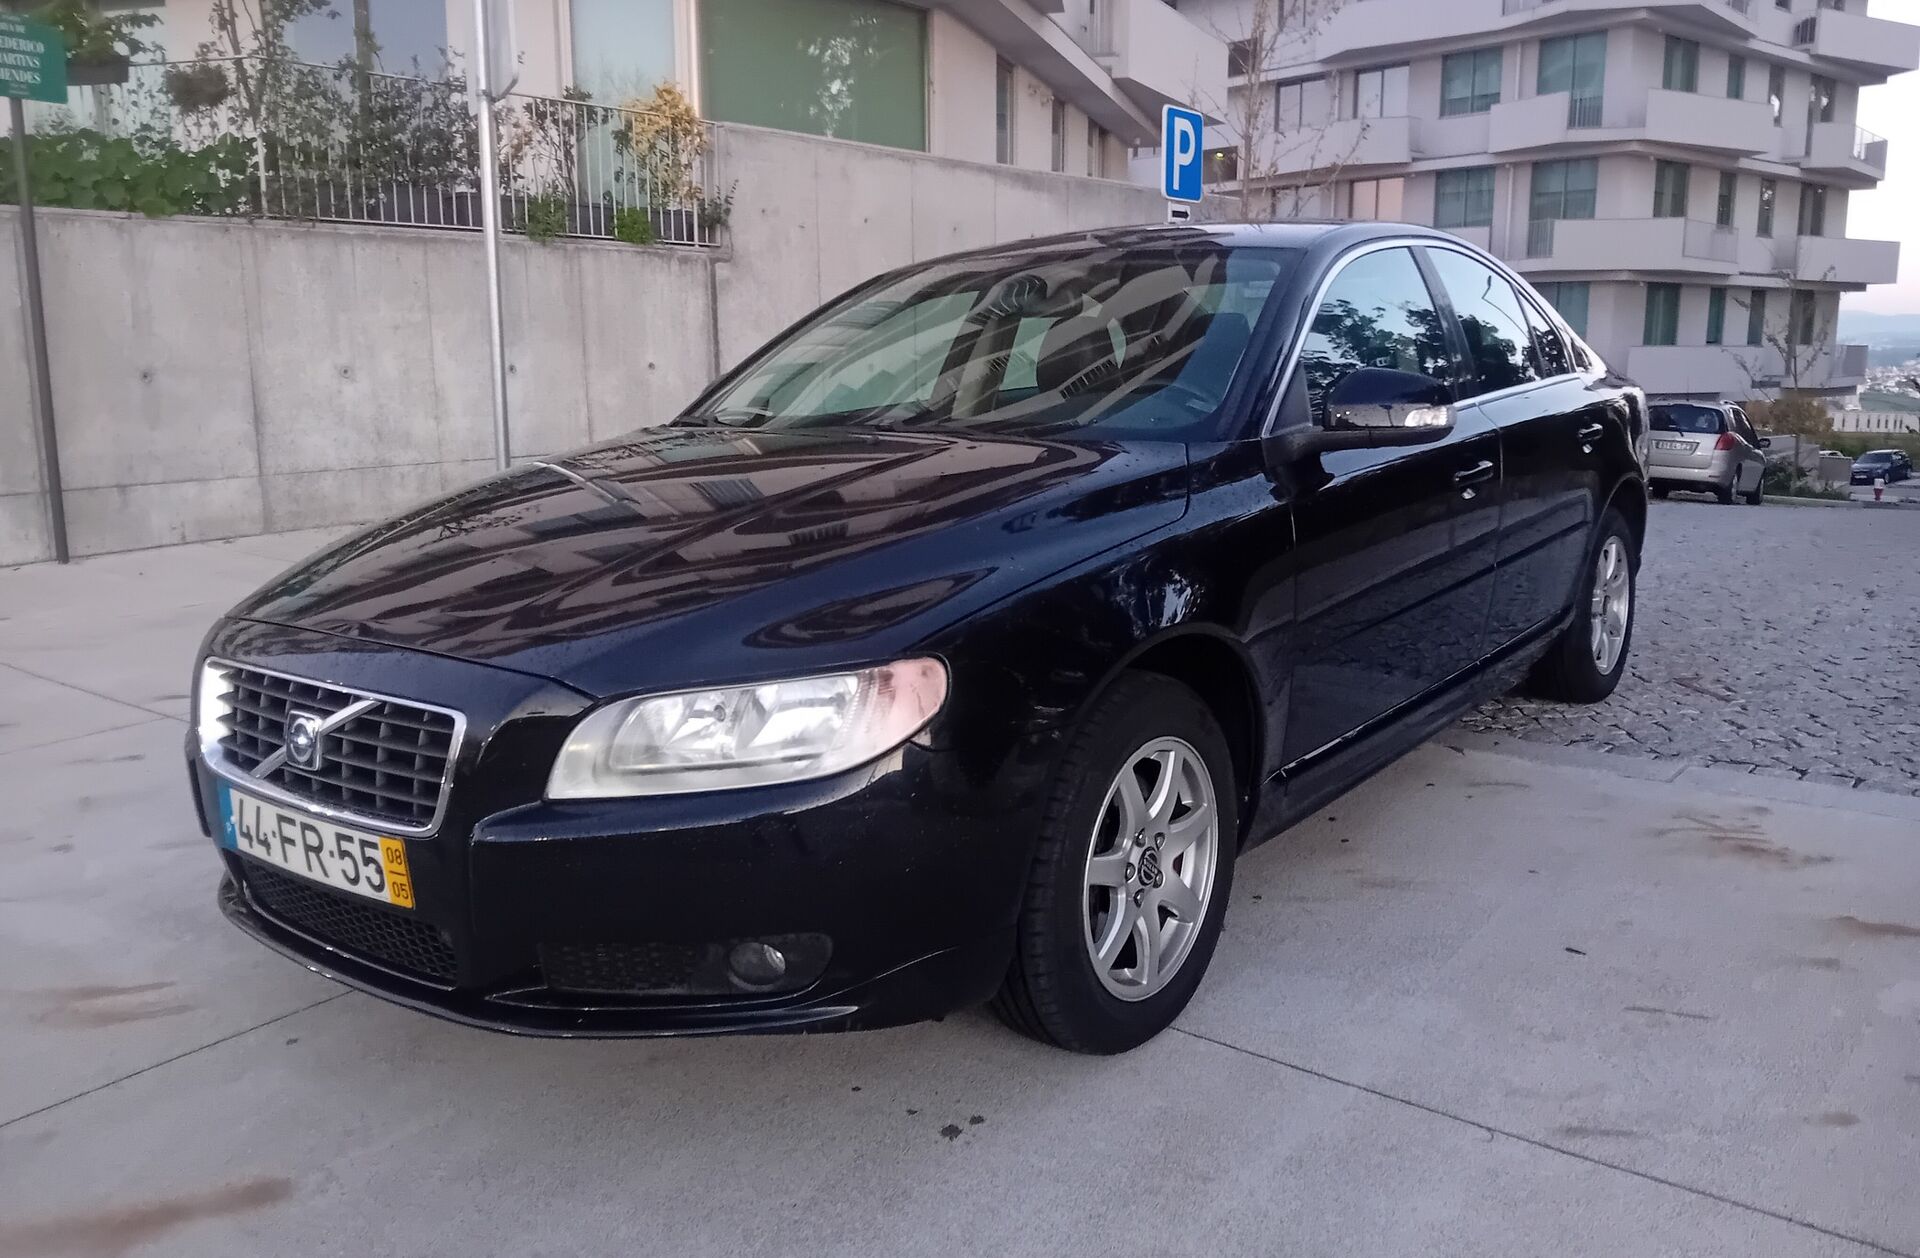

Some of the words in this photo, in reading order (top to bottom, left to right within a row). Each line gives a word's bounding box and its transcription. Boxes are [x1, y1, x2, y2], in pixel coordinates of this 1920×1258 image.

[0, 51, 40, 68] ARTINS
[1173, 116, 1196, 191] P
[386, 847, 403, 865] 08
[392, 882, 409, 899] 05
